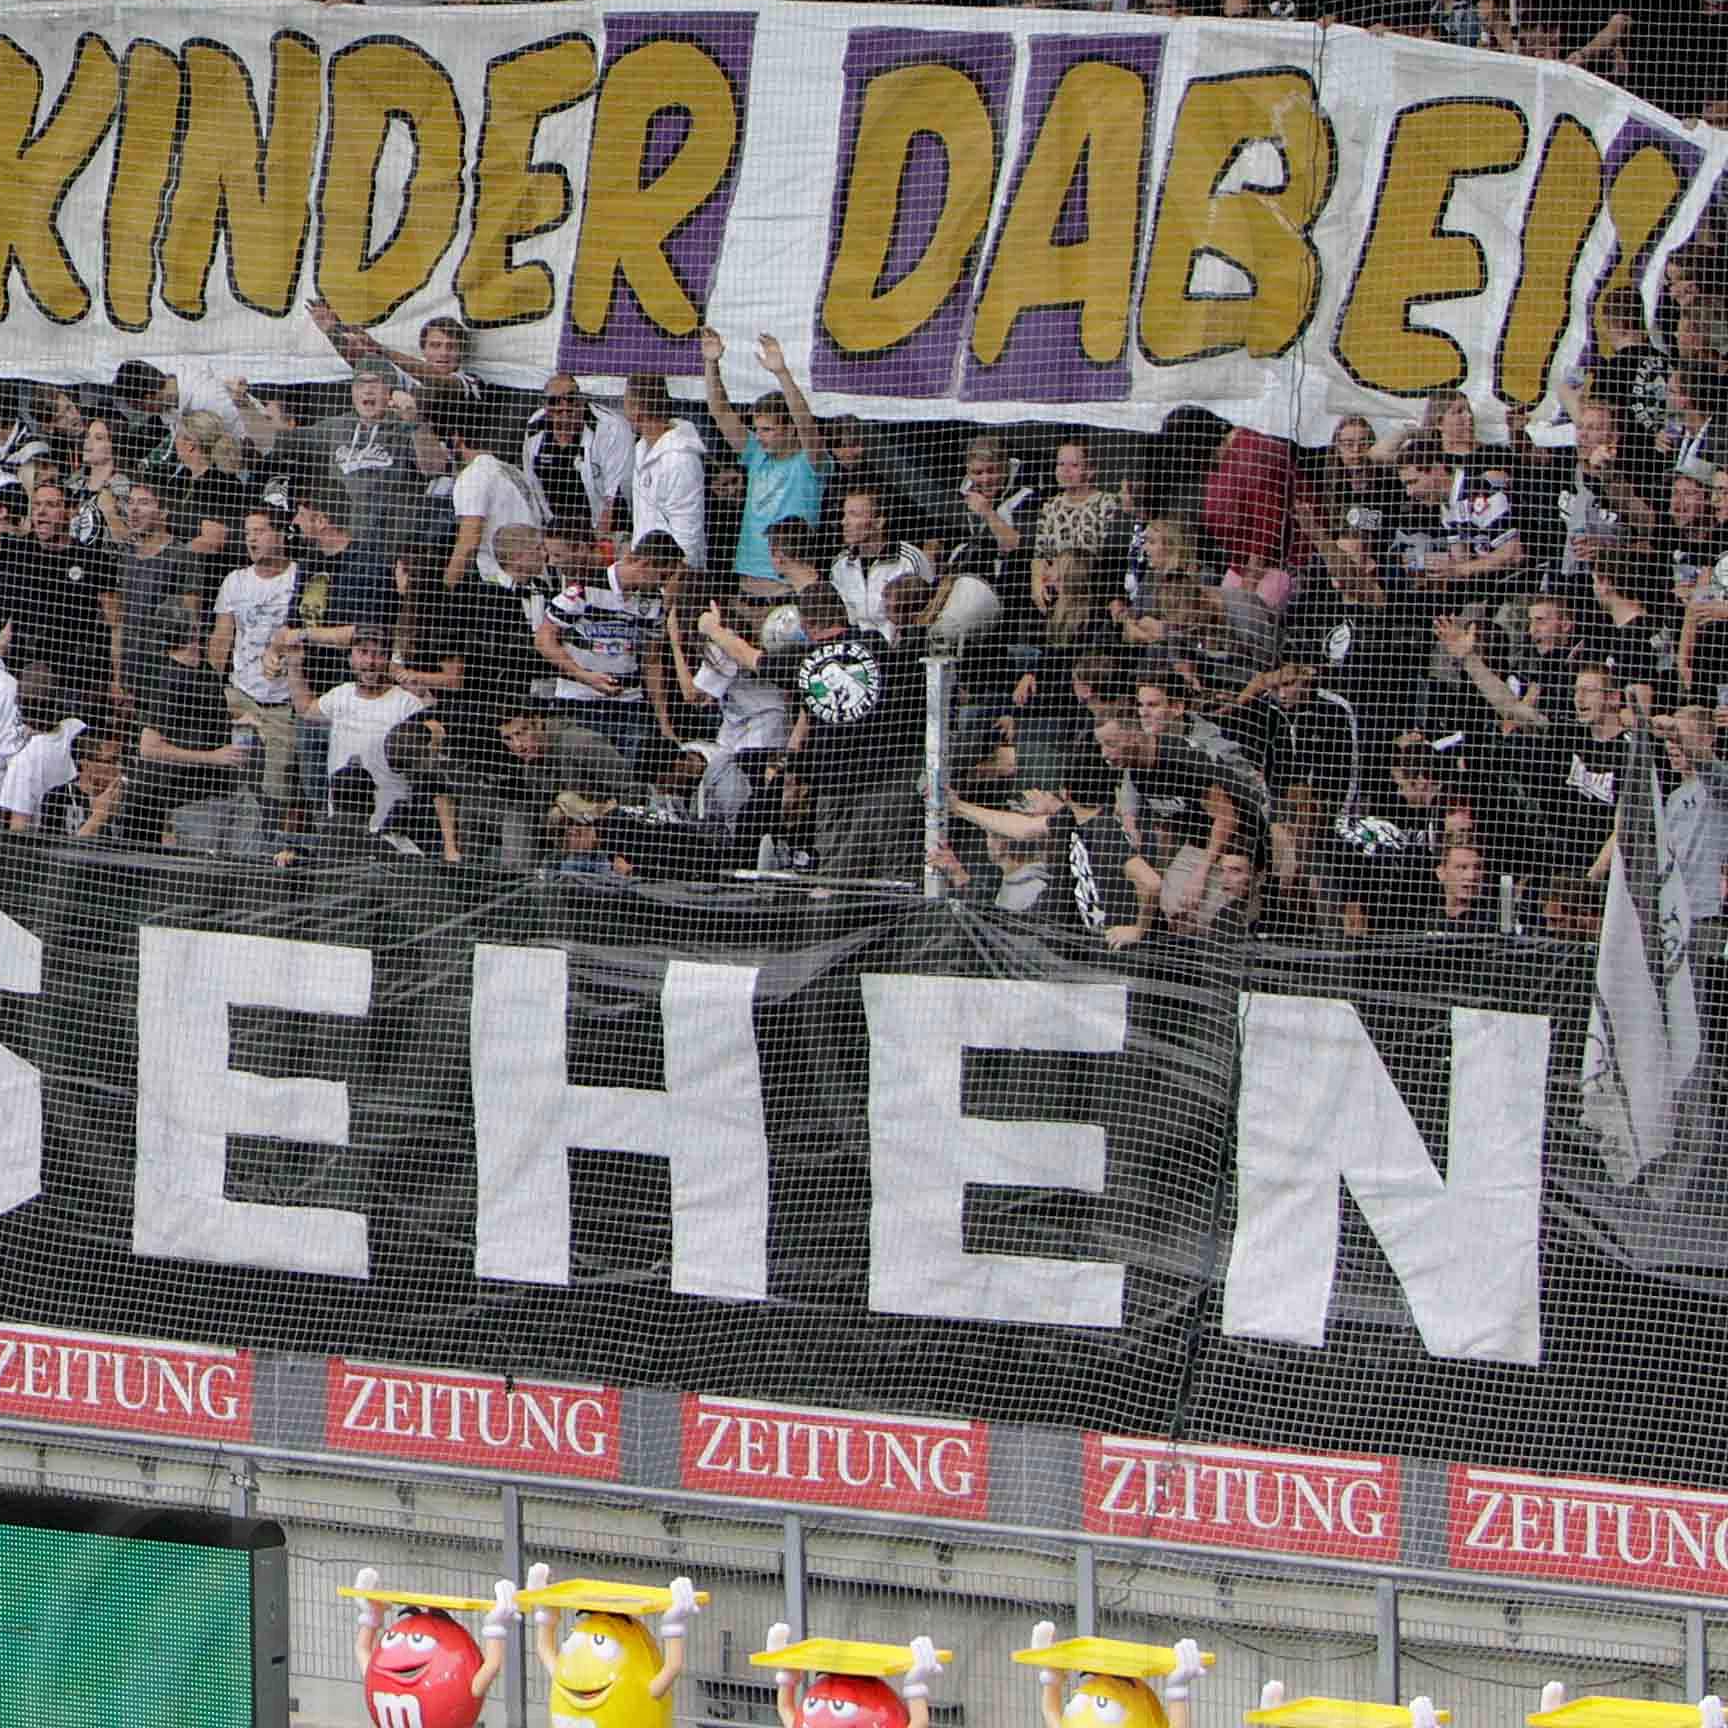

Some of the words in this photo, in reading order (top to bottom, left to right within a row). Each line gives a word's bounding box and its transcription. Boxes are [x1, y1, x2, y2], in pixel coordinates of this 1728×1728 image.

[343, 1374, 609, 1457] ZEITUNG
[695, 1412, 973, 1497] ZEITUNG
[1099, 1454, 1385, 1539] ZEITUNG
[1464, 1487, 1728, 1571] ZEITUN
